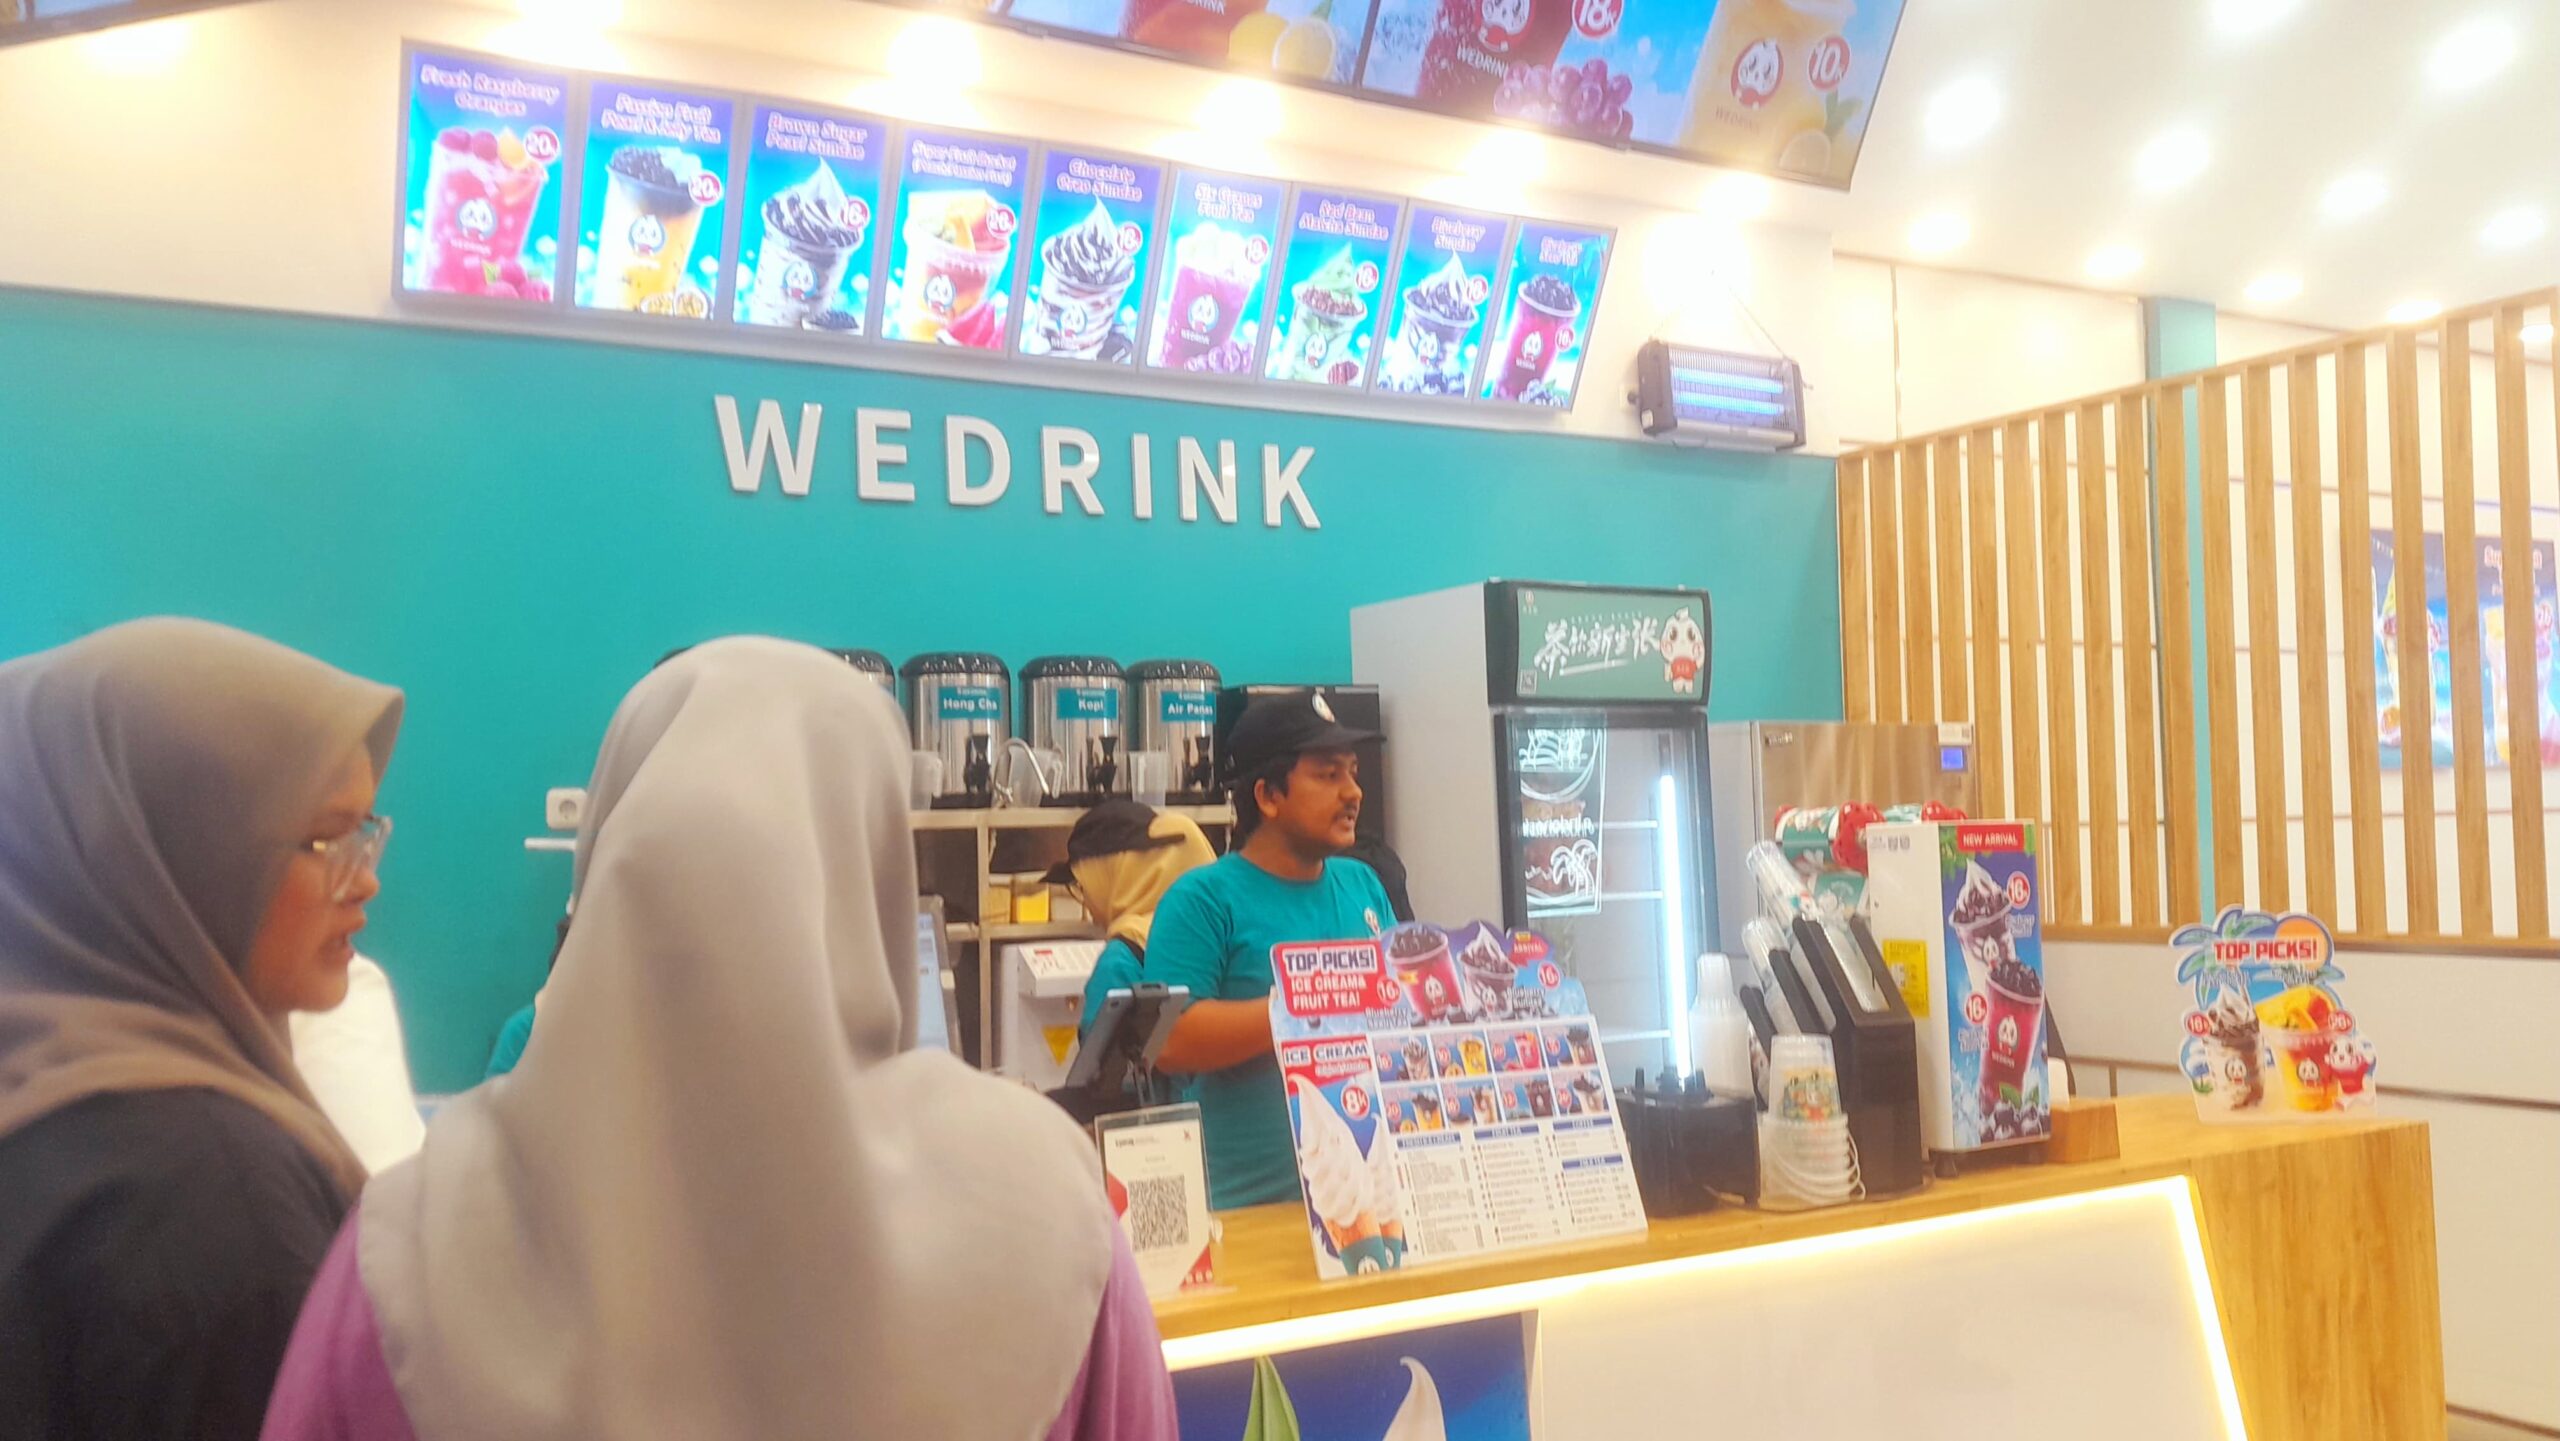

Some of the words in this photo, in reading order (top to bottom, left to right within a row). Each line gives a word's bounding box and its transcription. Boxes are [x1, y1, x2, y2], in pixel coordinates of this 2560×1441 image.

[714, 394, 1322, 530] WEDRINK
[943, 698, 975, 713] Hong
[978, 698, 998, 711] Cha
[1078, 698, 1104, 712] Kopi
[1168, 703, 1184, 715] Air
[1187, 703, 1213, 715] Panas
[1962, 833, 1983, 847] NEW
[1984, 832, 2019, 846] ARRIVAL
[2213, 942, 2250, 961] TOP
[2255, 940, 2318, 960] PICKS!
[1284, 952, 1318, 973] TOP
[1322, 949, 1376, 972] PICKS!
[1291, 977, 1312, 993] ICE
[1293, 993, 1328, 1011] FRUIT
[1333, 991, 1360, 1008] TEA!
[1286, 1050, 1308, 1064] ICE
[1315, 1044, 1368, 1061] CREAM
